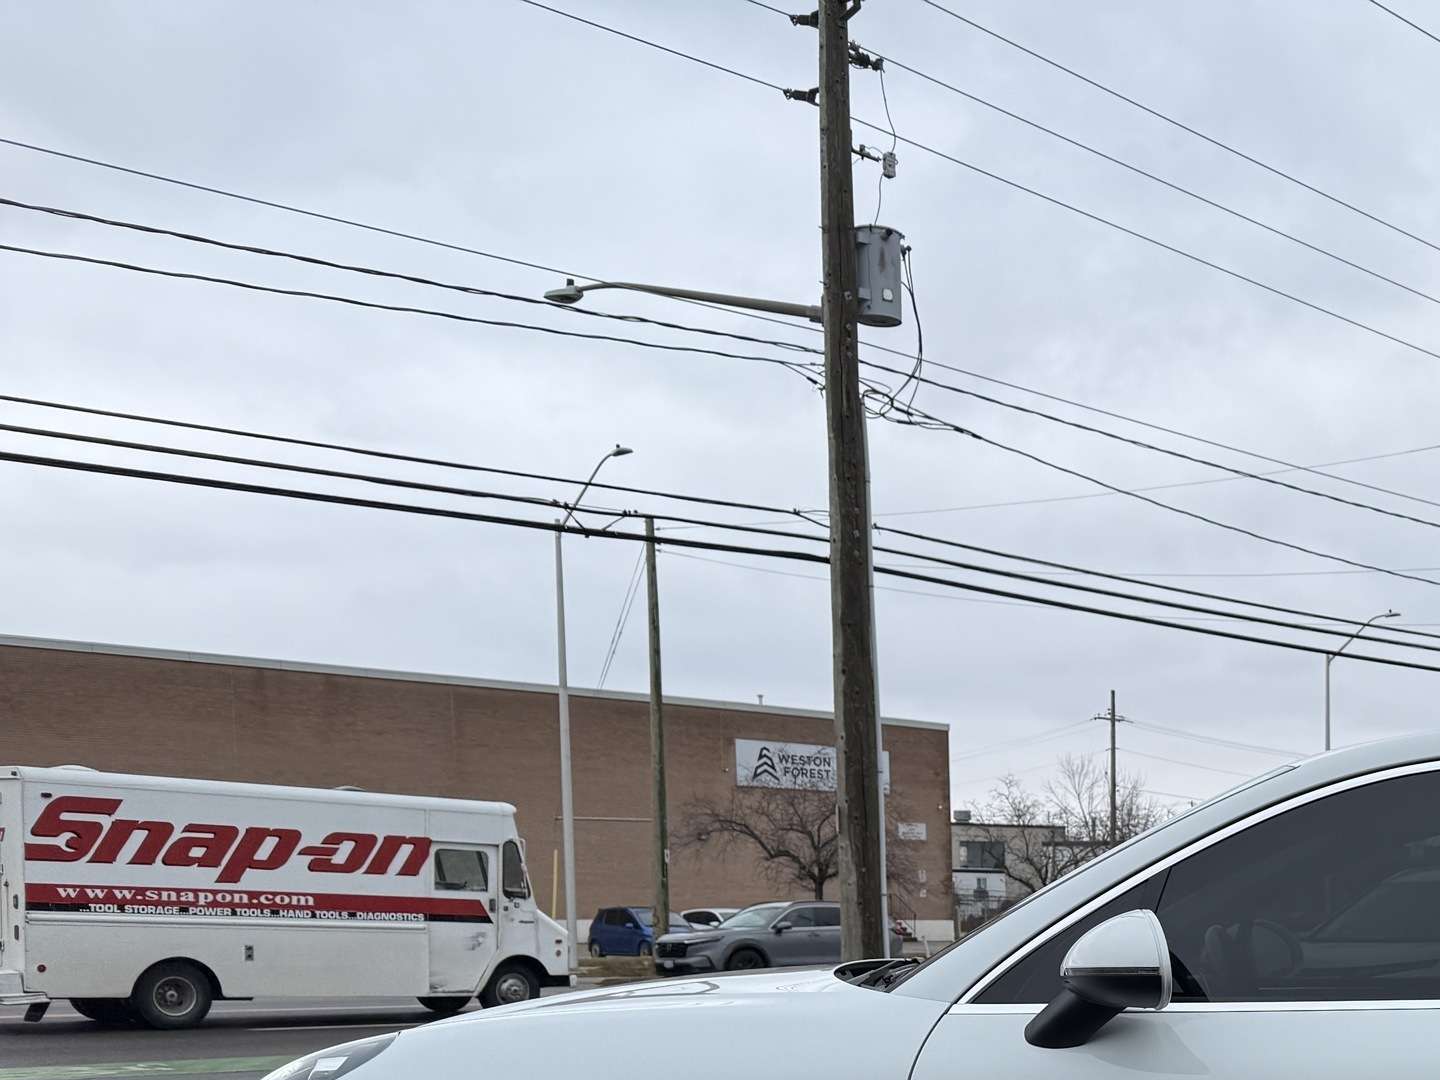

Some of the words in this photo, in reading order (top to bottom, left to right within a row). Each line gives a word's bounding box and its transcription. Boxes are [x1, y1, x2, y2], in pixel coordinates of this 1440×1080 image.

[778, 753, 831, 767] WESTON
[783, 766, 831, 779] FOREST
[25, 796, 432, 883] Snap-on
[56, 887, 315, 906] www.snapon.com
